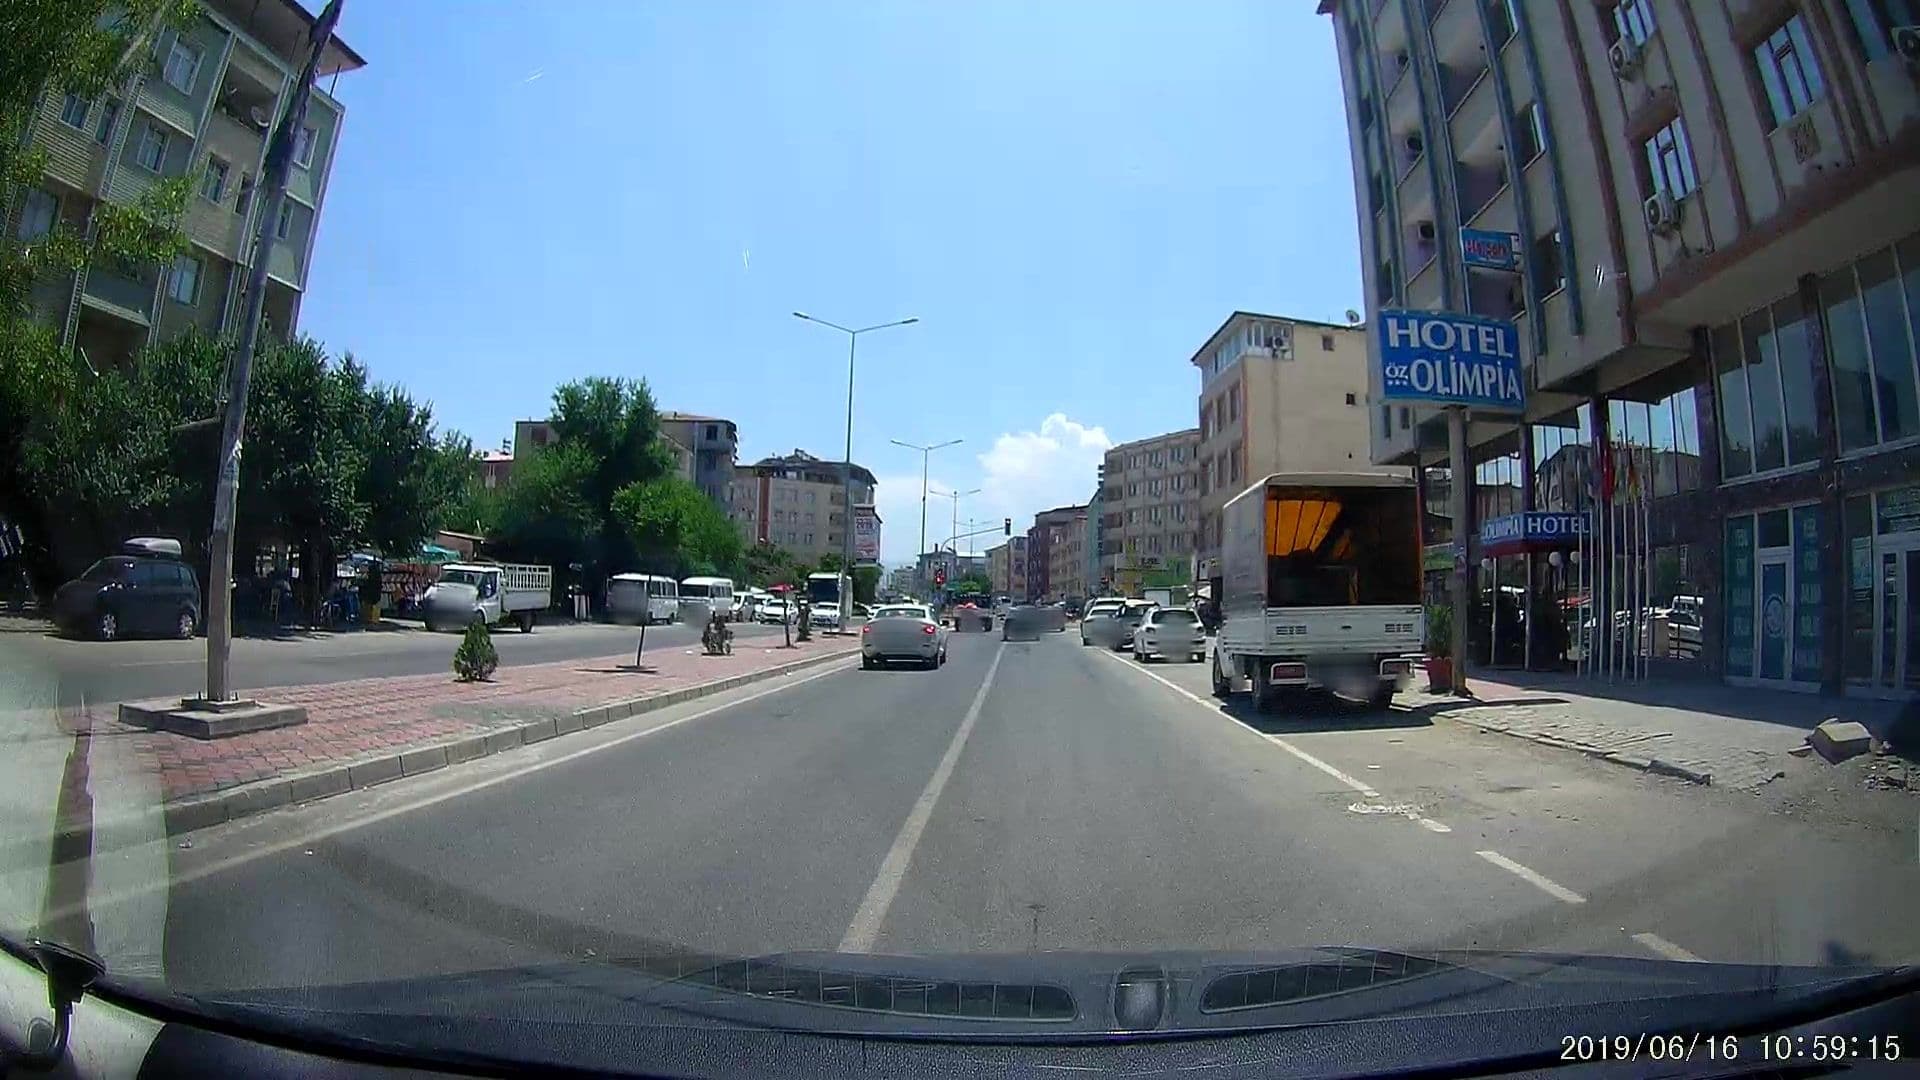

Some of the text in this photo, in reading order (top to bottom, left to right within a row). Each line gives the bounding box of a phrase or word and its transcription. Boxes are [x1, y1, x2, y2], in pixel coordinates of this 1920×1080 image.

[1386, 317, 1513, 359] HOTEL
[1385, 354, 1522, 401] ÖZ OLİMPİA
[1527, 516, 1590, 533] HOTEL
